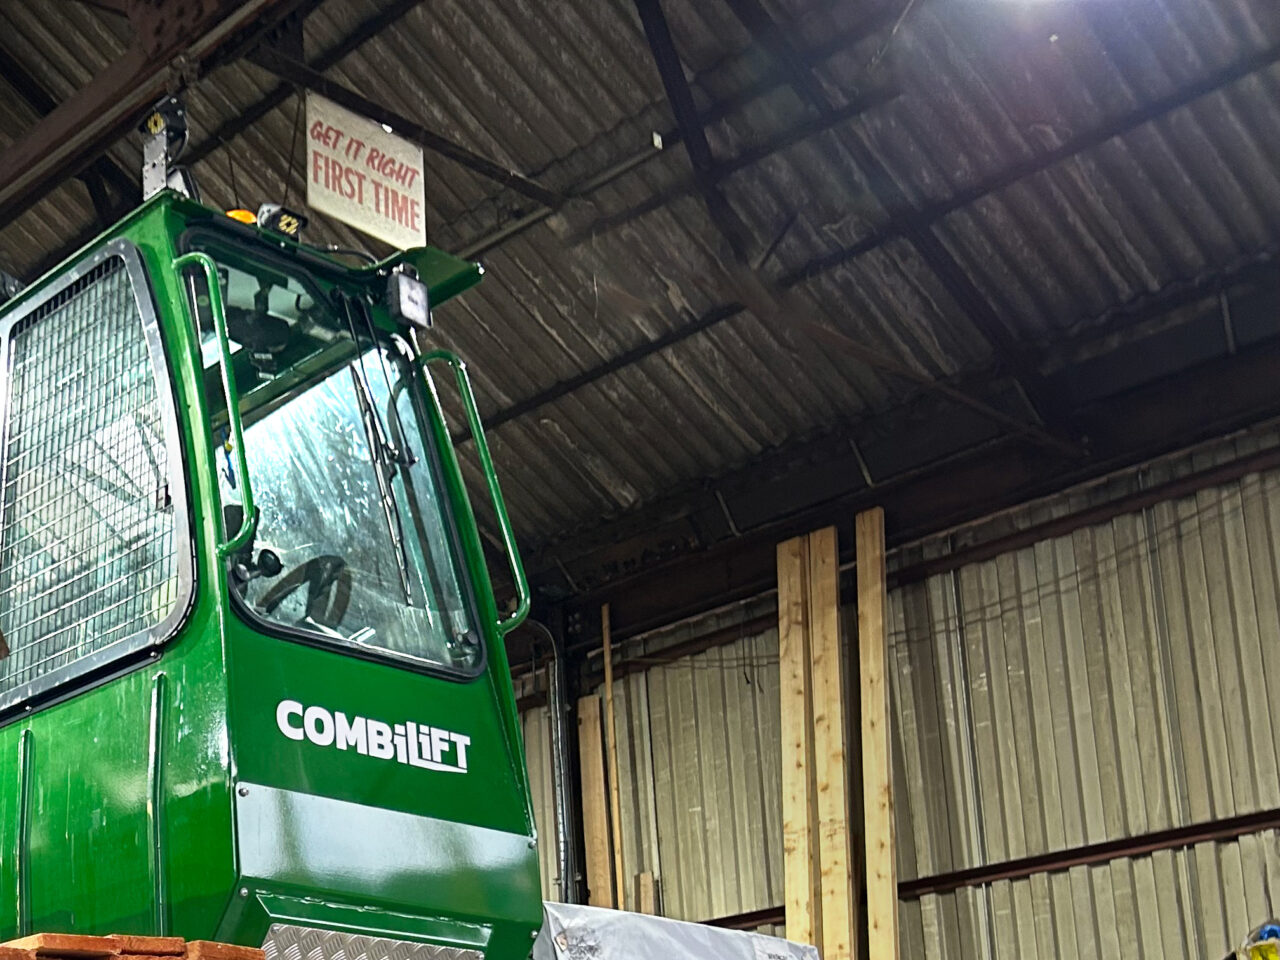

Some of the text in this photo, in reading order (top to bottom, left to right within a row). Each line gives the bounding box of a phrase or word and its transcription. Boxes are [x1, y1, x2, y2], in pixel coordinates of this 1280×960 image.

[310, 120, 419, 189] GET IT RIGHT
[312, 150, 420, 232] FIRST TIME
